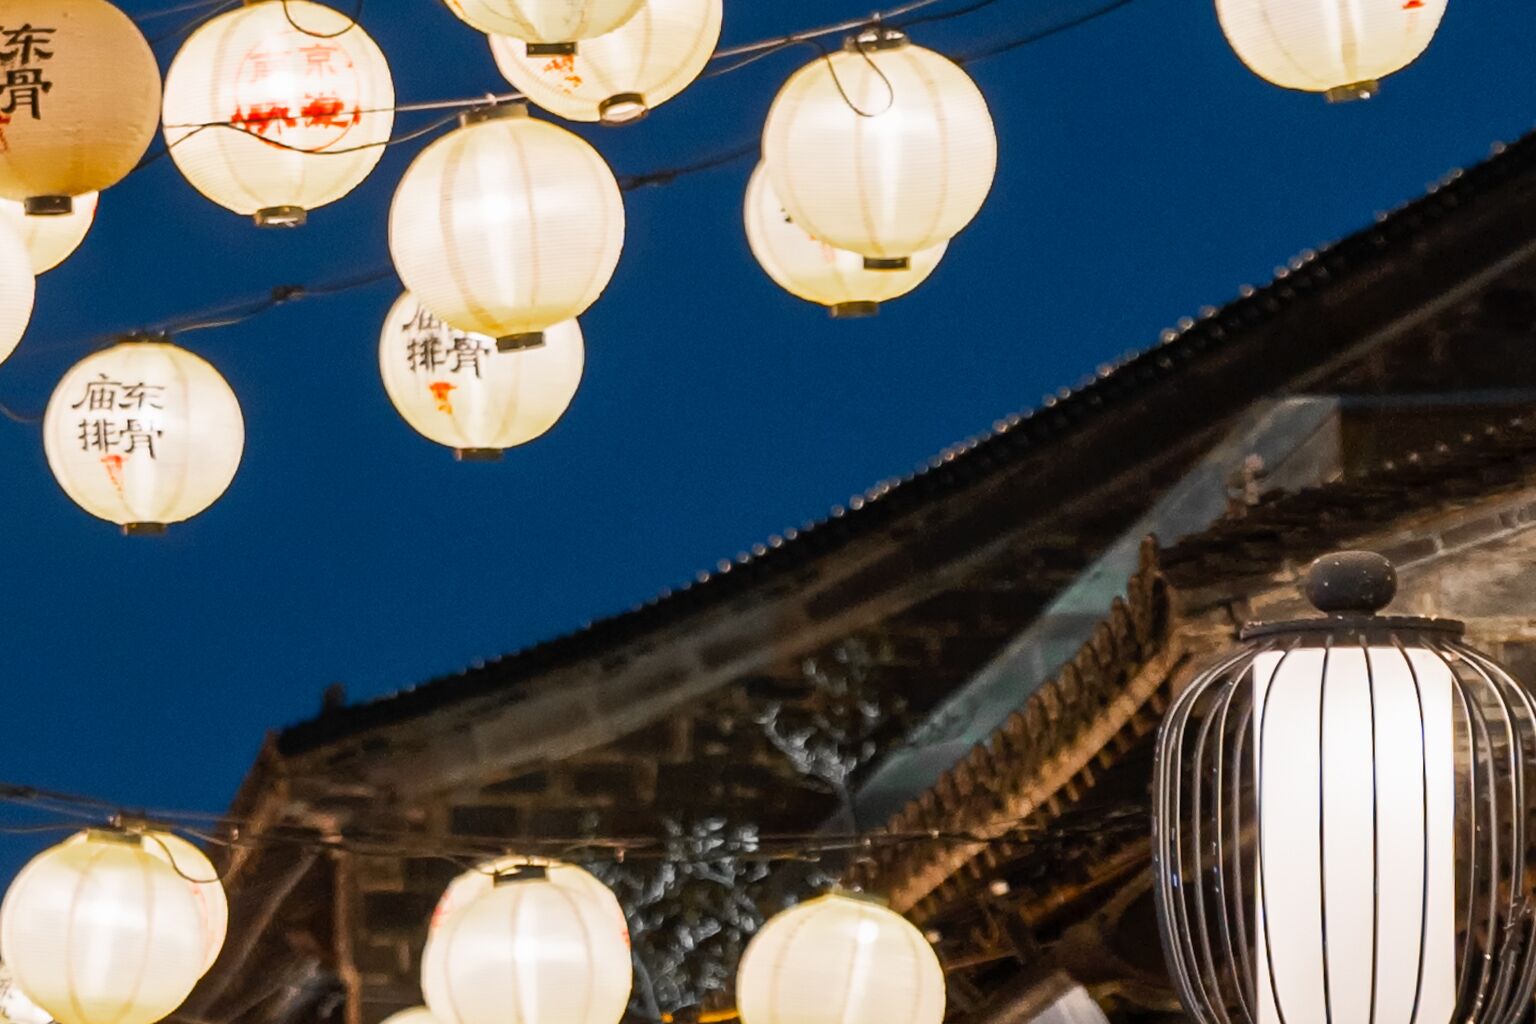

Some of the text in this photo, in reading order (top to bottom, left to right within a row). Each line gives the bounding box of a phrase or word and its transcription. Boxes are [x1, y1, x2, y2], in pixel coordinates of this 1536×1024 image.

[406, 335, 491, 380] 排骨
[71, 372, 166, 411] 庙东
[77, 418, 164, 460] 排骨
